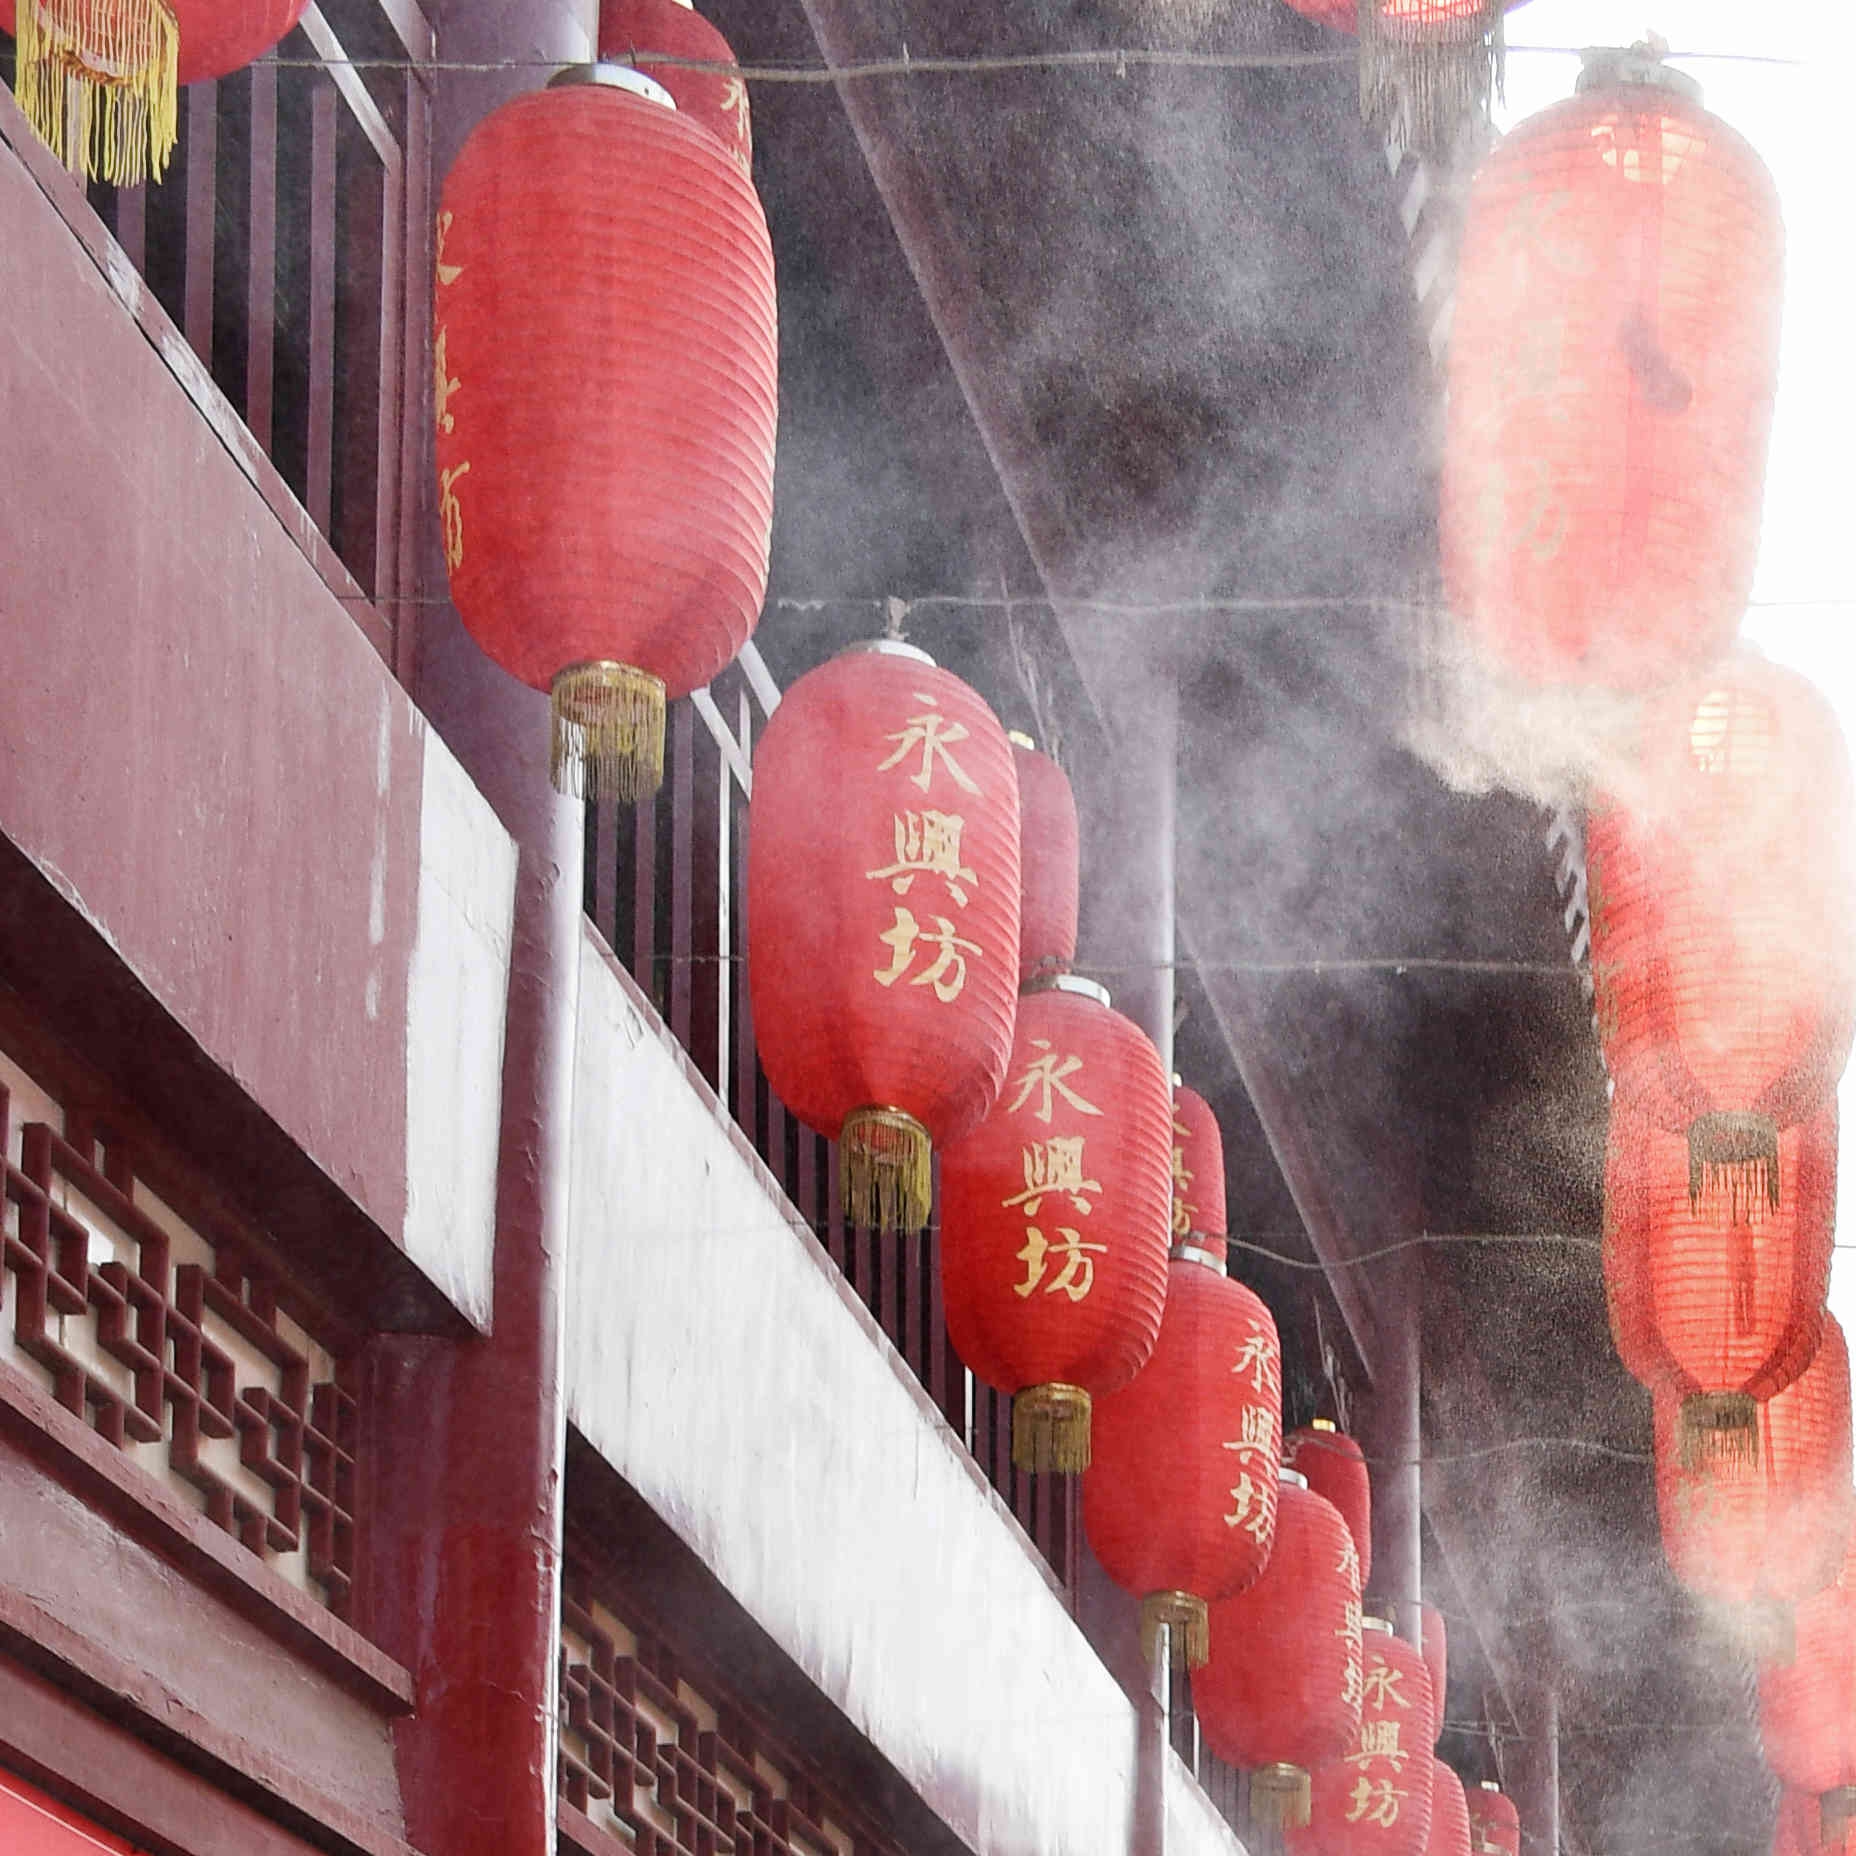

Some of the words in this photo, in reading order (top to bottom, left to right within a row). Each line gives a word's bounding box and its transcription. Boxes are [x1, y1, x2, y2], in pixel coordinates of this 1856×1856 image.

[865, 690, 984, 1003] 永興坊
[1001, 1037, 1107, 1303] 永興坊
[1222, 1317, 1282, 1546] 永興坊
[1343, 1654, 1411, 1830] 永興坊
